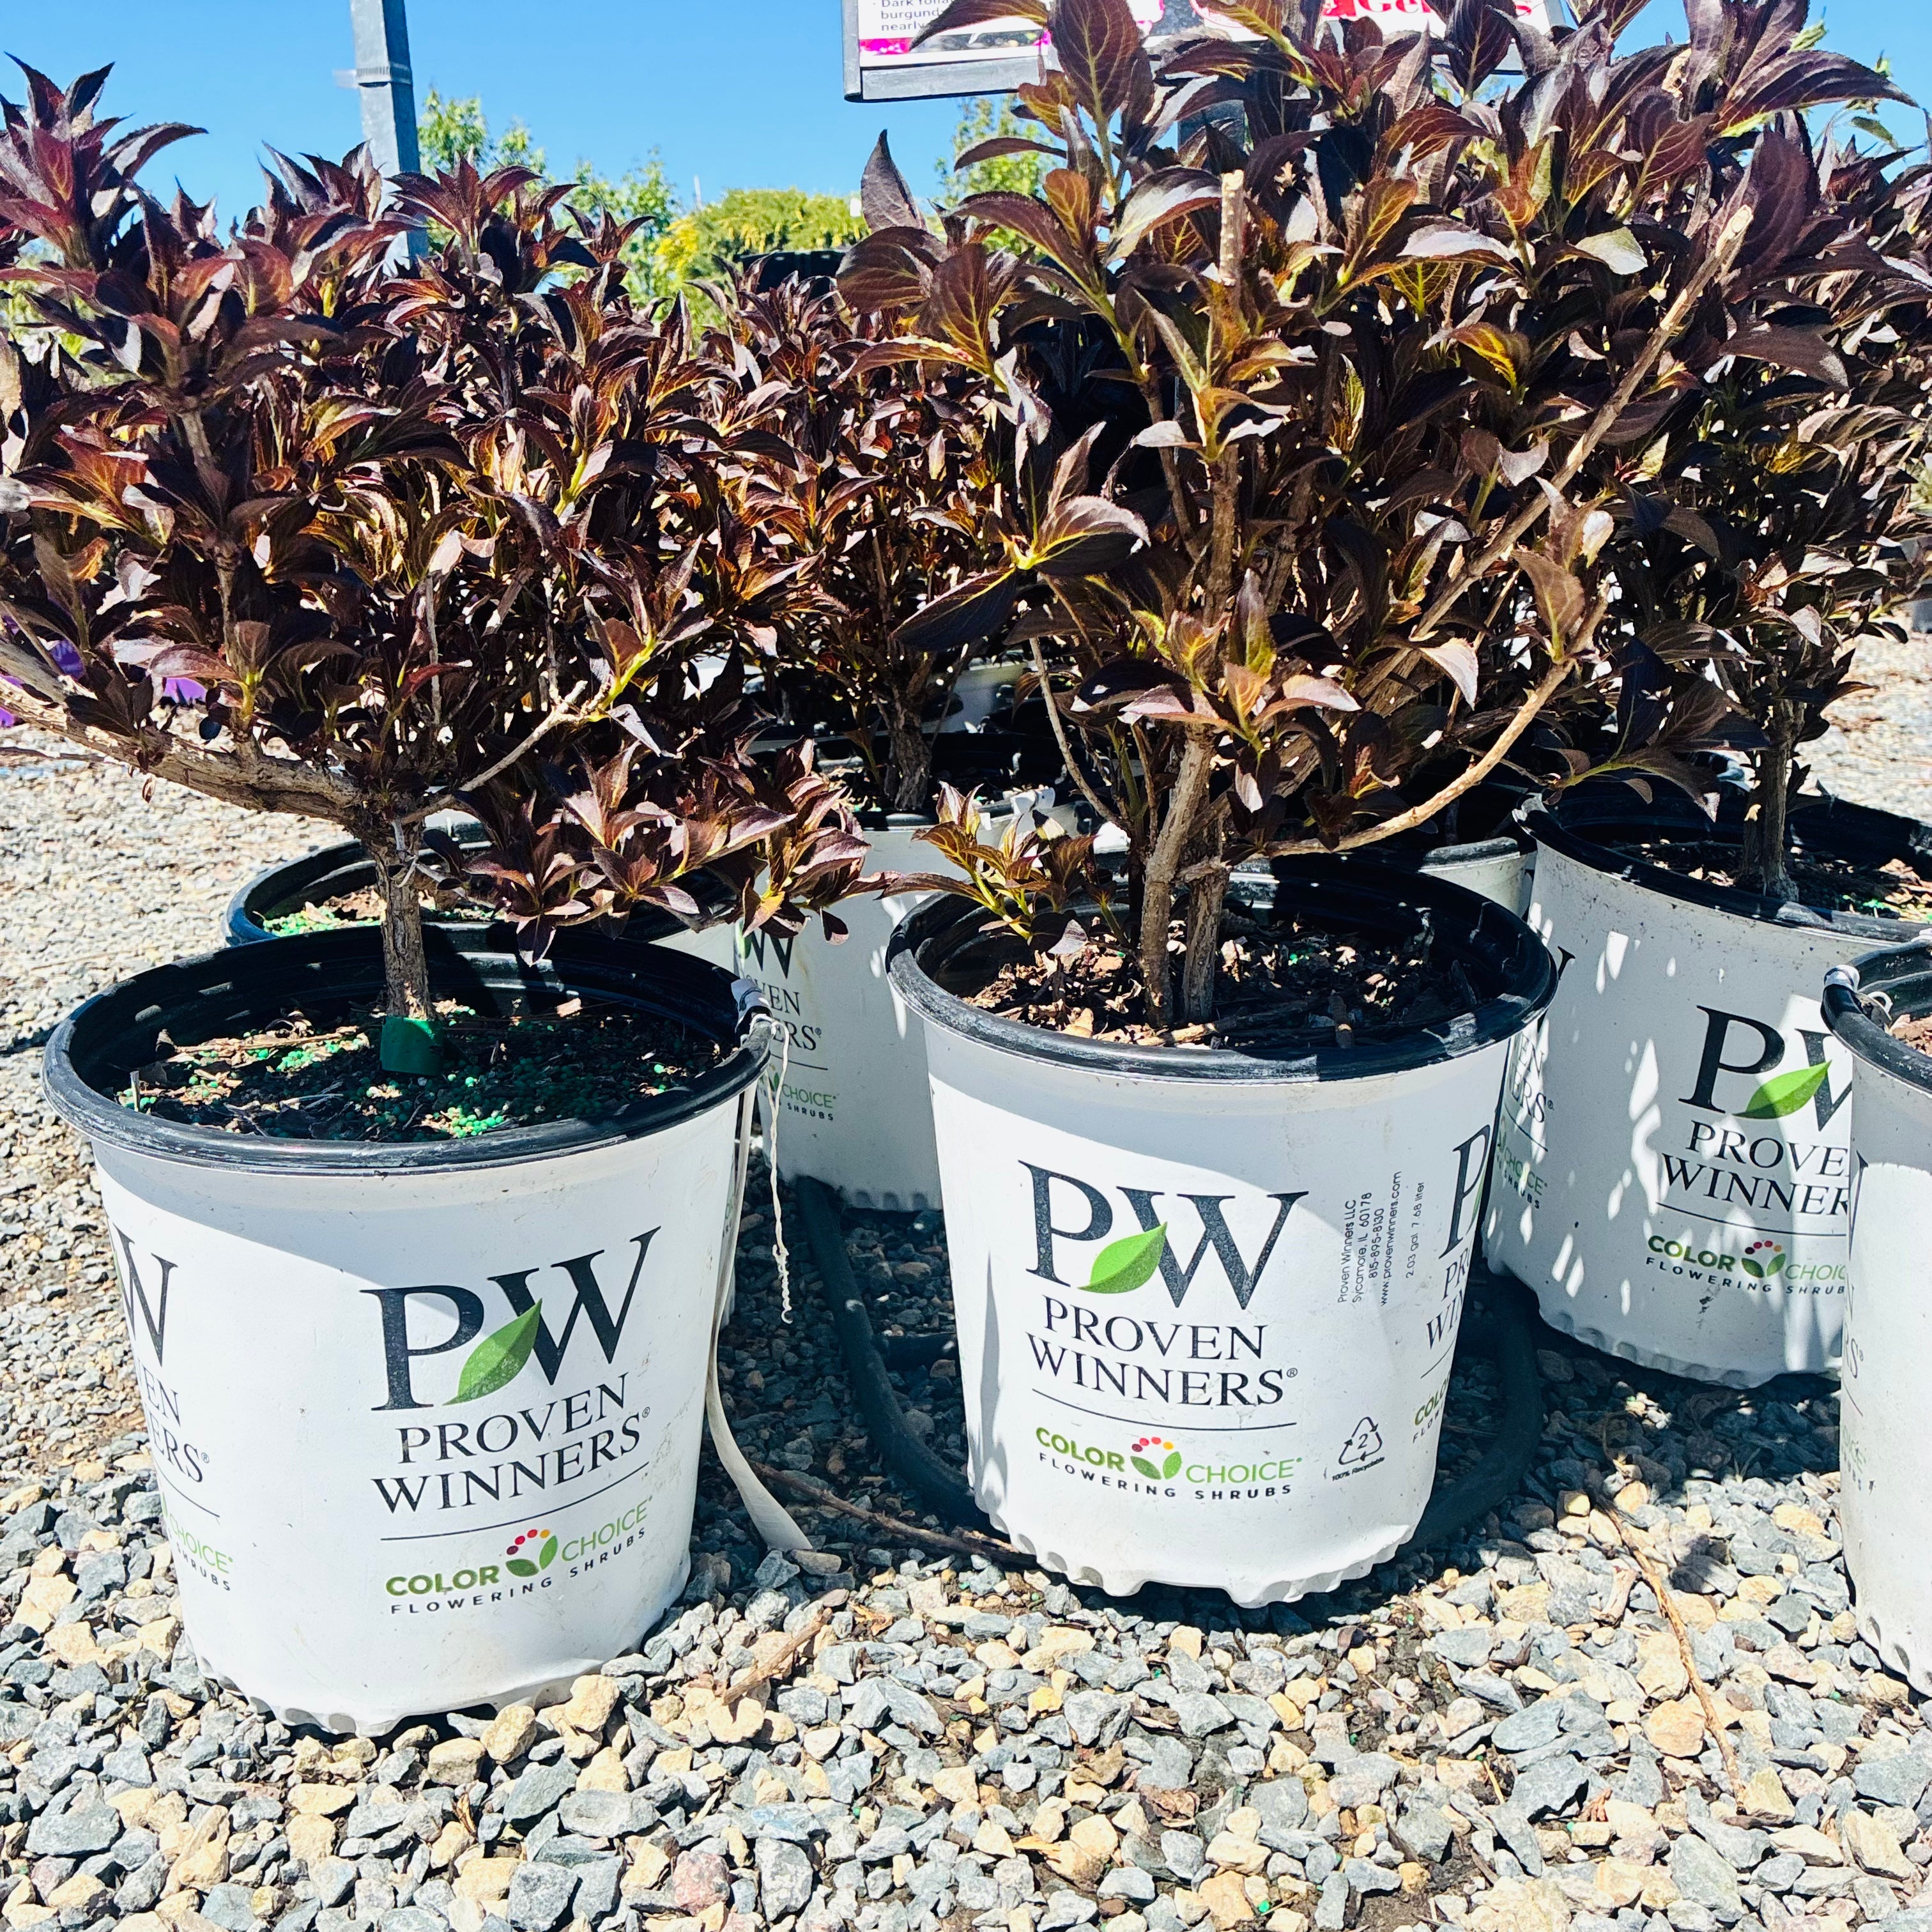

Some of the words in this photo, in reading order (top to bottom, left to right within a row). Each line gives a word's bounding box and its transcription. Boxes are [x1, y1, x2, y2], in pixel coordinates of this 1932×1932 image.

[881, 7, 946, 20] burgund
[782, 1084, 834, 1109] CHOICE
[787, 1101, 834, 1121] SHRUBS
[1685, 1120, 1849, 1177] PROVE
[1344, 1199, 1356, 1220] LLC
[1359, 1192, 1372, 1227] 60178
[1661, 1153, 1848, 1216] WINNER
[1018, 1160, 1309, 1310] PW
[1341, 1222, 1354, 1265] Winners
[1358, 1233, 1368, 1243] IL
[1368, 1208, 1384, 1278] 815-895-8130
[1381, 1171, 1402, 1307] www.provenwinners.com
[1411, 1233, 1419, 1252] gal
[1415, 1182, 1425, 1201] liter
[1337, 1266, 1350, 1303] Proven
[1352, 1245, 1368, 1303] Sycamore,
[1646, 1257, 1772, 1293] FLOWERING
[1786, 1285, 1845, 1295] SHRUB
[1648, 1236, 1736, 1272] COLOR
[1784, 1264, 1846, 1281] CHOIC
[359, 1226, 661, 1411] PW
[1042, 1294, 1266, 1360] PROVEN
[398, 1374, 626, 1464] PROVEN
[1358, 1433, 1368, 1450] 2
[1036, 1426, 1125, 1471] COLOR
[1186, 1458, 1295, 1484] CHOICE
[1039, 1452, 1176, 1498] FLOWERING
[1195, 1485, 1292, 1500] SHRUBS
[386, 1565, 499, 1596] COLOR
[561, 1499, 648, 1563] CHOICE
[391, 1577, 553, 1614] FLOWERING
[570, 1528, 645, 1577] SHRUBS
